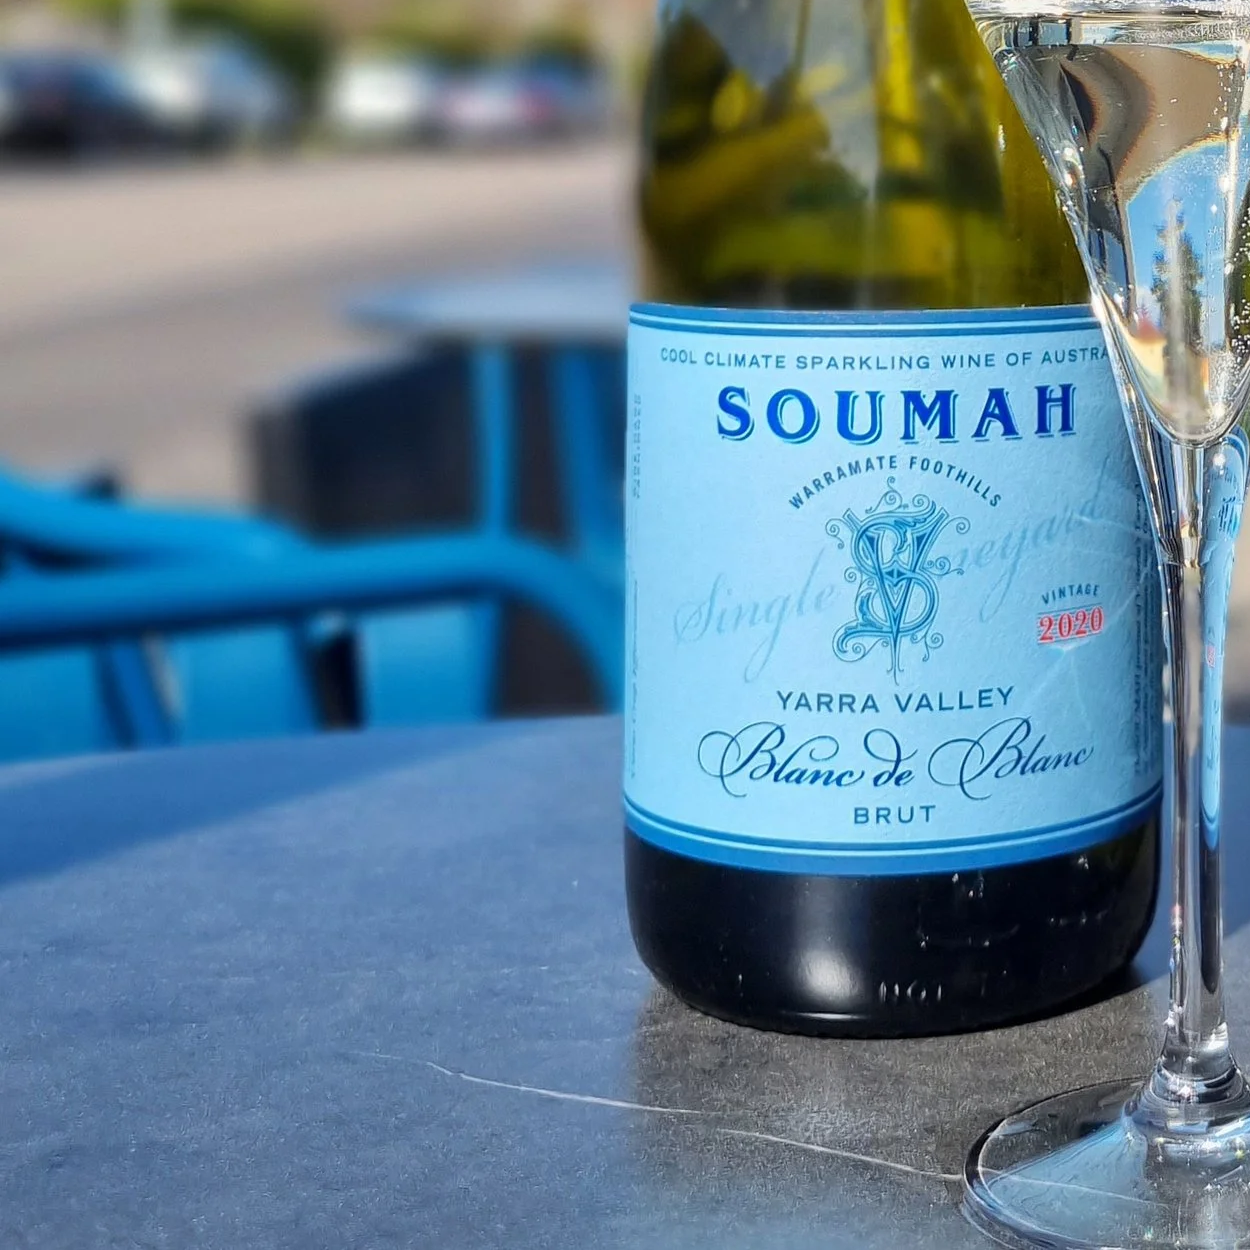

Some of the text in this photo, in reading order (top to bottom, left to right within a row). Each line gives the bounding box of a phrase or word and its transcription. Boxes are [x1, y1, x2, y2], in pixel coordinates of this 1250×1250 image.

[660, 346, 1110, 370] COOL CLIMATE SPARKLING WINE OF AUSTRA
[716, 383, 1077, 445] SOUMAH
[789, 455, 1003, 510] WARRAMATE FOOTHILLS
[1041, 583, 1101, 605] VINTAGE
[674, 547, 838, 682] Single
[1037, 606, 1105, 643] 2020
[777, 686, 1015, 714] YARRA VALLEY
[697, 716, 1095, 801] Blanc de Blanc
[853, 804, 937, 825] BRUT
